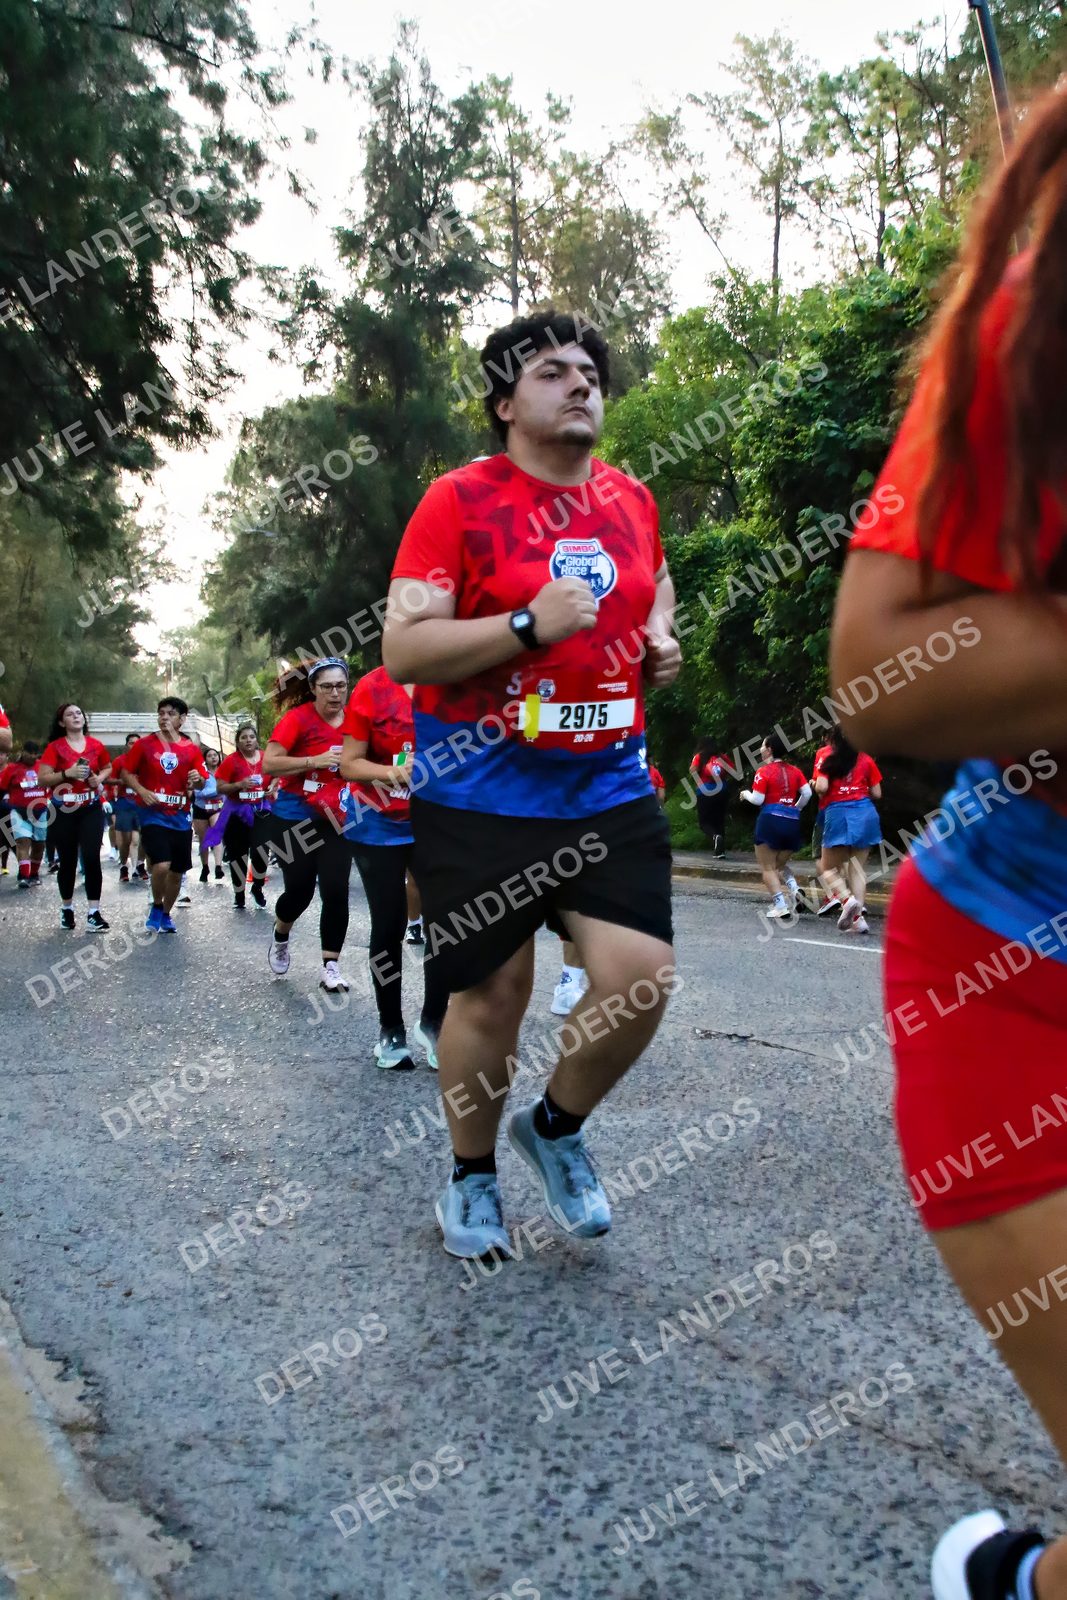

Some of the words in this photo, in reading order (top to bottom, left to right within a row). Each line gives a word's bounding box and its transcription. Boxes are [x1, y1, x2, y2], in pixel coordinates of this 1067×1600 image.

[562, 545, 596, 553] BIMBO
[565, 555, 598, 567] Global
[561, 565, 588, 576] Race
[559, 703, 609, 730] 2975
